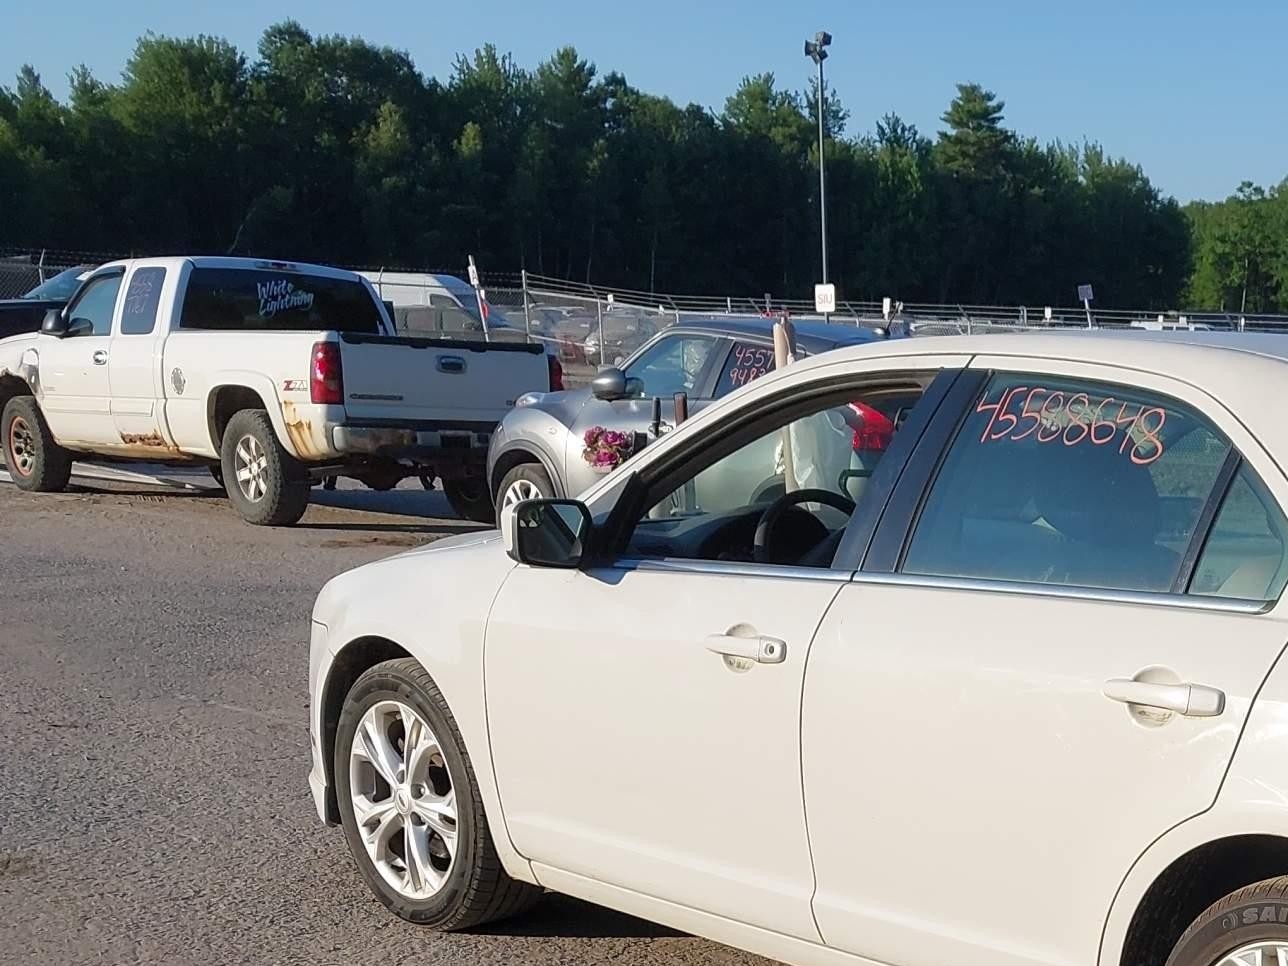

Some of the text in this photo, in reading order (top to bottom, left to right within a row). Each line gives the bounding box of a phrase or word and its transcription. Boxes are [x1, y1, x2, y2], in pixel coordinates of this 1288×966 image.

[257, 279, 295, 299] White
[817, 293, 833, 305] SIU
[258, 290, 315, 318] Lightning
[736, 345, 775, 369] 4557
[976, 386, 1166, 465] 45588648
